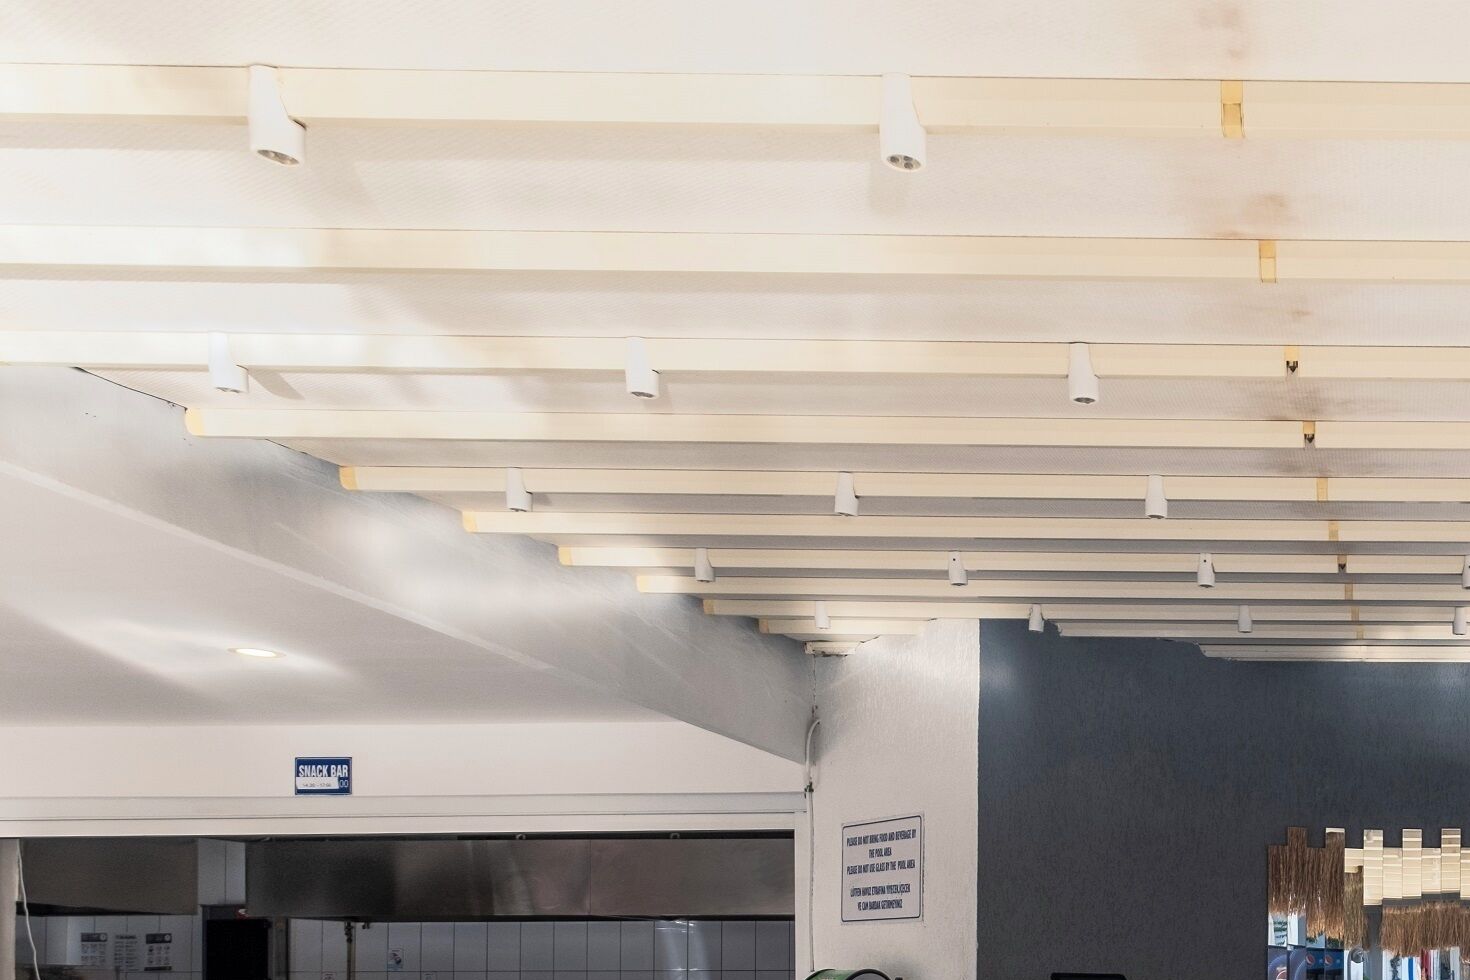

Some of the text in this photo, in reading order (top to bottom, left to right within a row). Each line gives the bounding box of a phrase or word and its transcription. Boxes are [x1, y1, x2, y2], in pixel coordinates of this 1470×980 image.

[299, 765, 348, 777] SNACK BAR
[847, 837, 857, 847] PLEASE
[858, 836, 862, 845] DO
[869, 834, 878, 844] BRING
[879, 832, 887, 842] FOOD
[896, 830, 911, 840] BEVERAGE
[875, 847, 883, 858] POOL
[884, 847, 892, 857] AREA
[847, 865, 857, 875] PLEASE
[858, 864, 862, 874] DO
[876, 862, 885, 872] GLASS
[885, 861, 890, 871] BY
[897, 860, 906, 870] POOL
[907, 859, 915, 869] AREA
